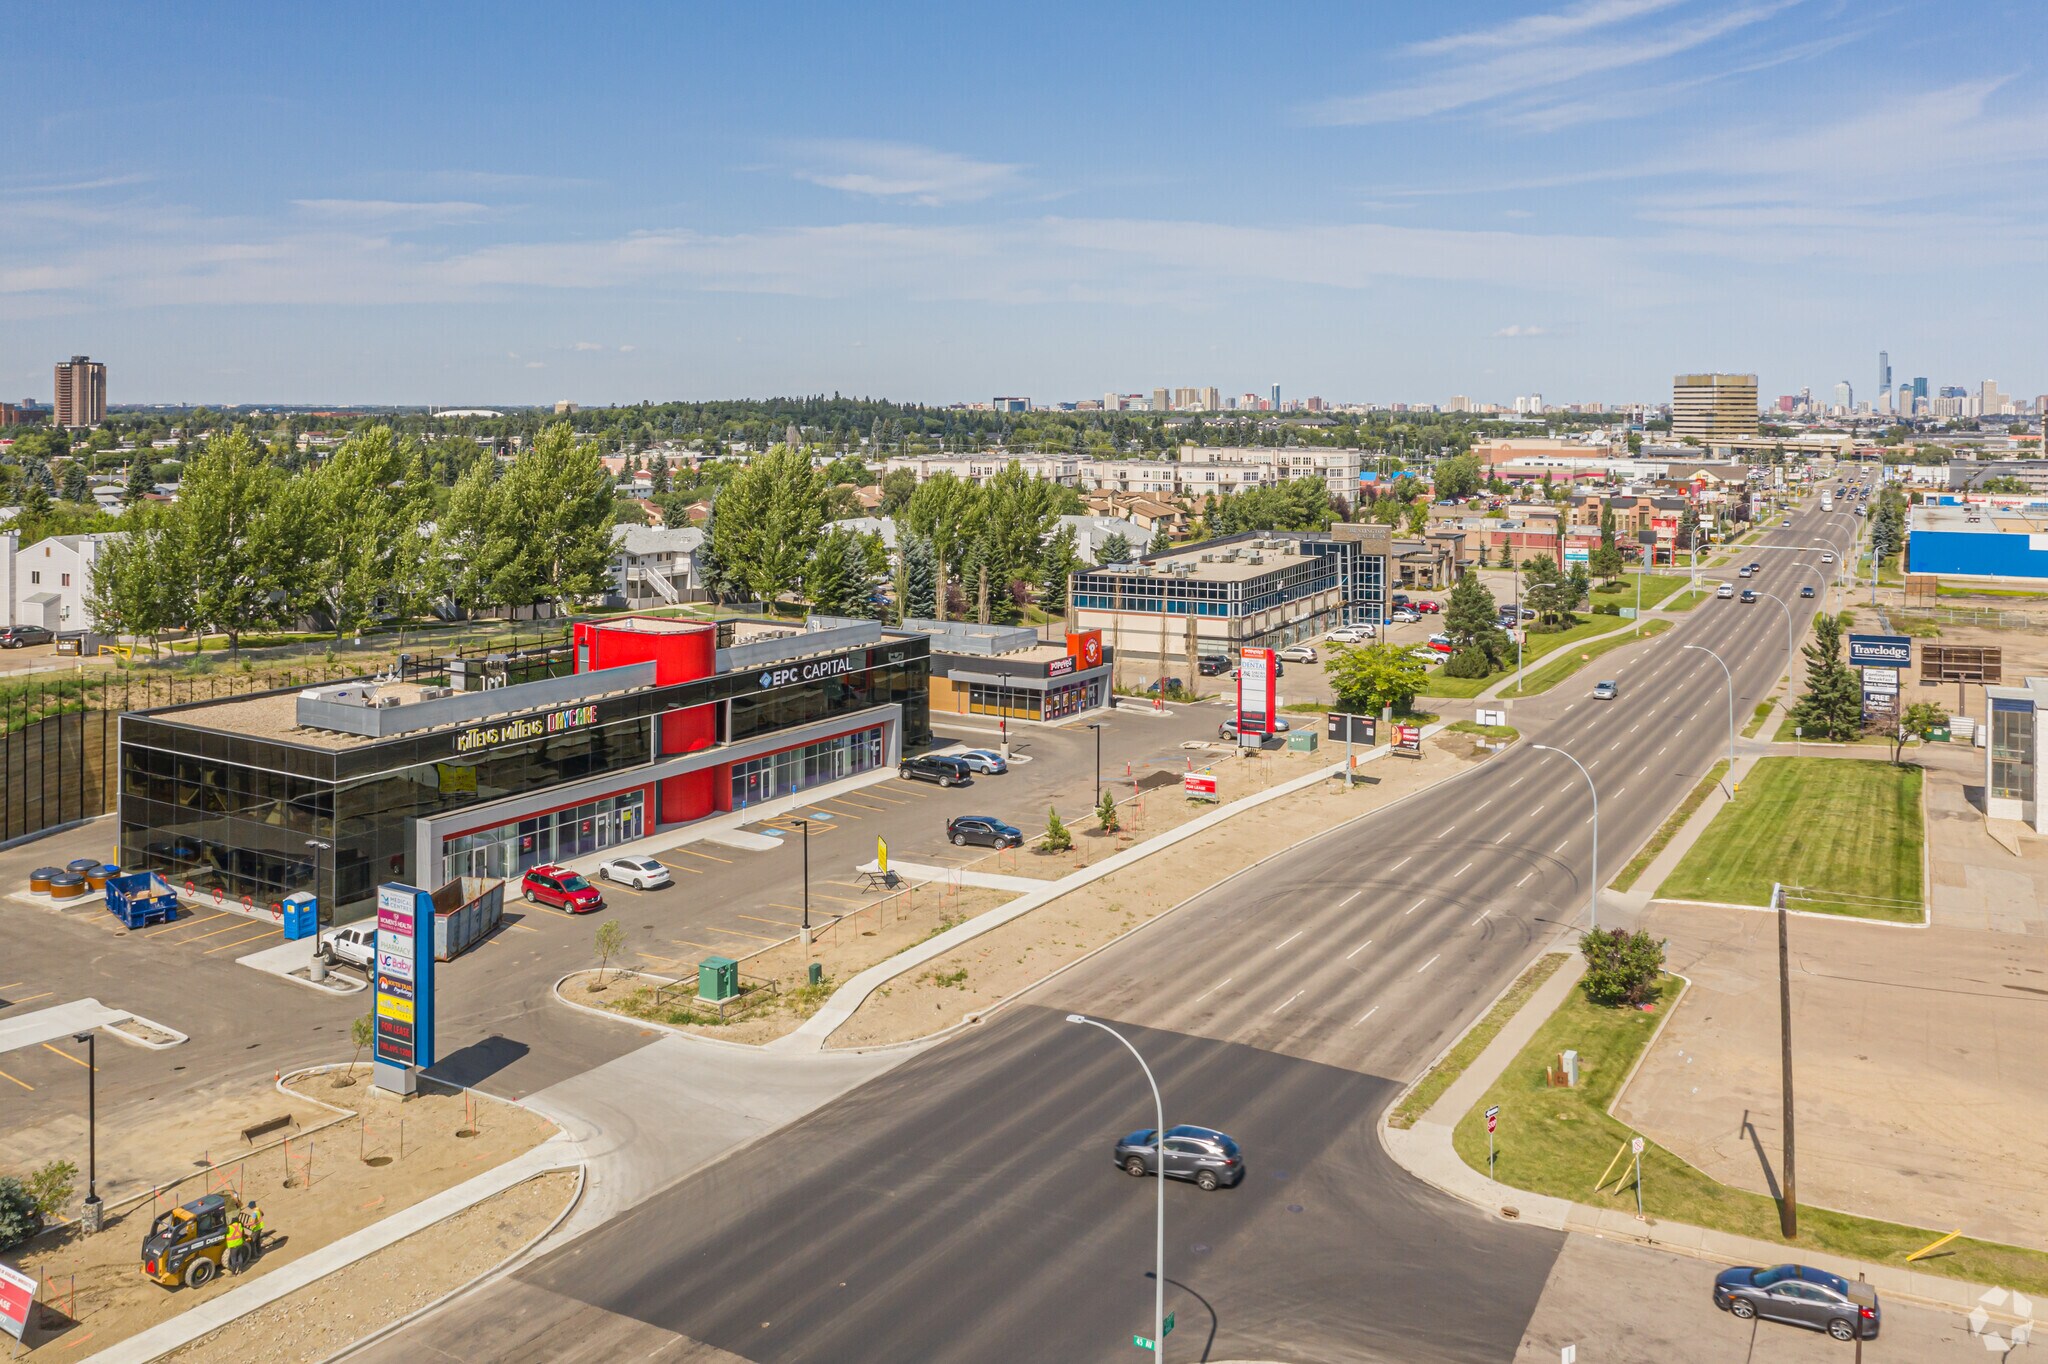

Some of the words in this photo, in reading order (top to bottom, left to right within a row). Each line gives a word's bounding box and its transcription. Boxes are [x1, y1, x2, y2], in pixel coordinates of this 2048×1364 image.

[1853, 644, 1907, 659] Travelodge
[773, 668, 798, 686] EPC
[803, 657, 853, 679] CAPITAL
[1241, 661, 1266, 669] DENTAL
[1870, 694, 1890, 702] FREE
[547, 705, 598, 732] DAYCARE
[389, 895, 413, 906] MEDICAL
[380, 941, 411, 955] PHARMACY
[392, 957, 412, 973] Baby
[381, 1020, 393, 1033] FOR
[393, 1024, 410, 1038] LEASE
[206, 1234, 225, 1245] DEERE
[1136, 1338, 1144, 1347] 45
[1145, 1340, 1153, 1350] AV
